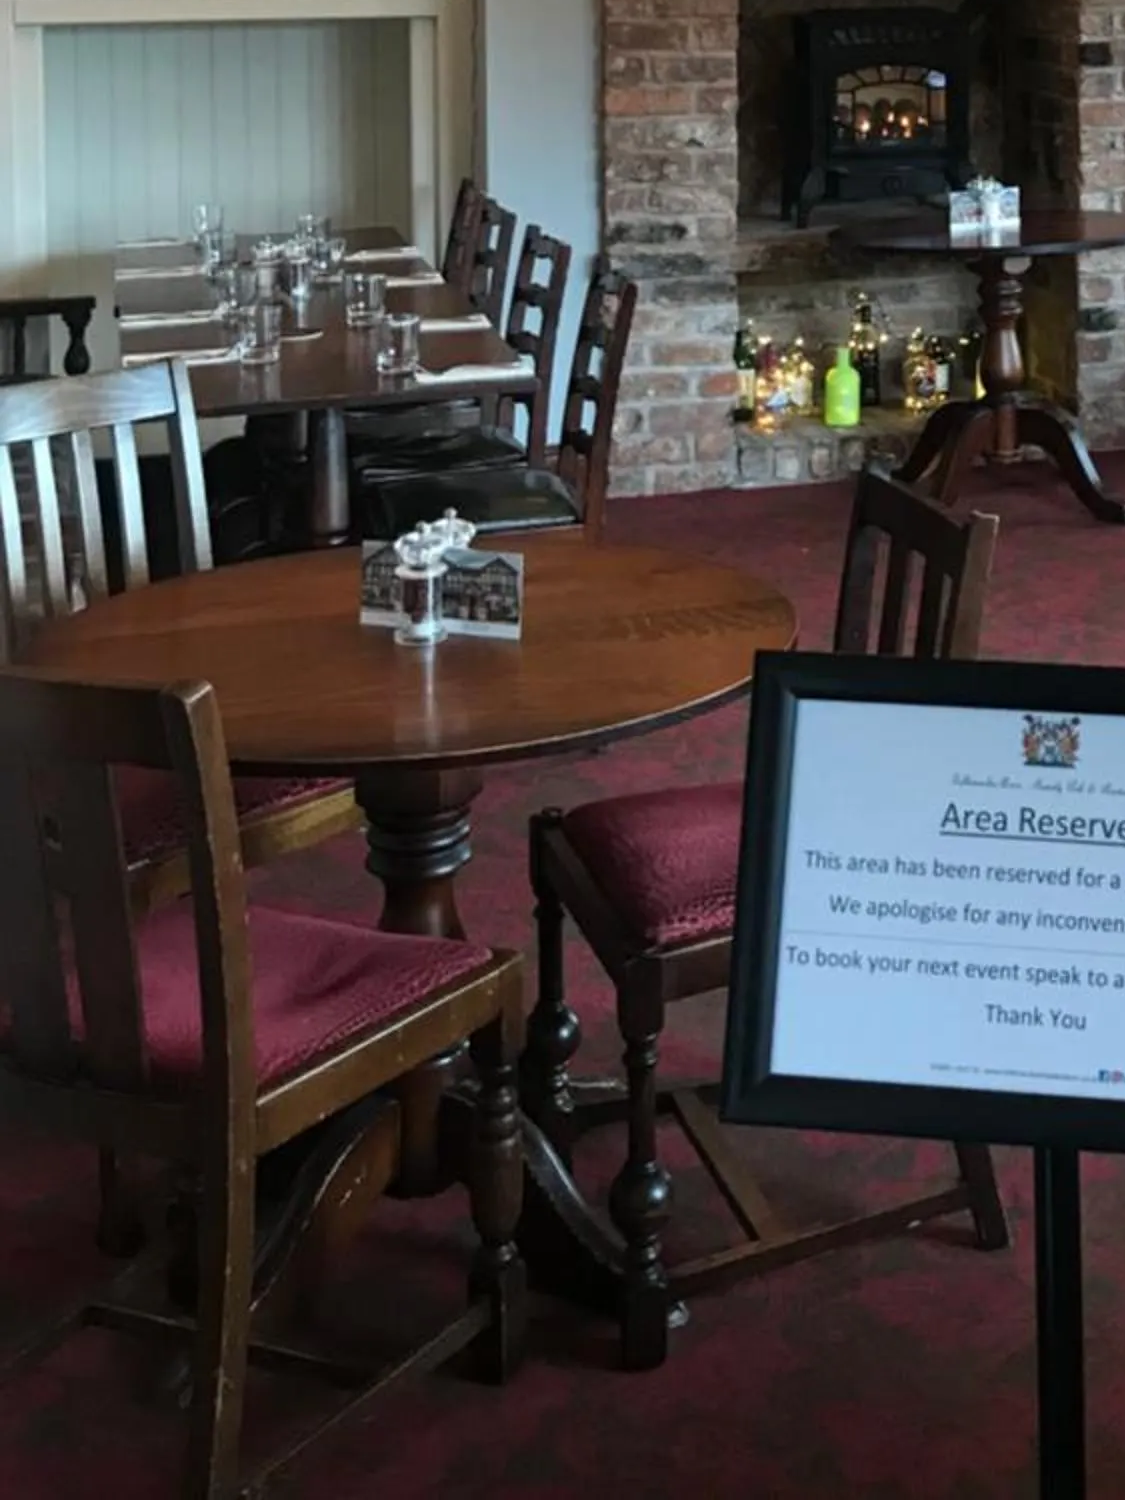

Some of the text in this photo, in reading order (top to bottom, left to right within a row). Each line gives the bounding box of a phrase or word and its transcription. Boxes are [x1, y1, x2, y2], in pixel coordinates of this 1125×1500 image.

[941, 802, 1008, 832] Area
[804, 850, 842, 870] This
[846, 857, 889, 873] area
[895, 857, 927, 876] has
[932, 859, 980, 879] been
[986, 867, 1070, 886] reserved
[1076, 868, 1106, 887] for
[1109, 875, 1121, 890] a
[829, 895, 862, 914] We
[866, 900, 957, 924] apologise
[963, 904, 991, 924] for
[996, 911, 1033, 931] any
[786, 946, 810, 965] To
[815, 948, 862, 968] book
[867, 956, 912, 976] your
[917, 960, 959, 976] next
[964, 964, 1020, 981] event
[1025, 965, 1081, 988] speak
[1088, 970, 1108, 988] to
[1113, 974, 1125, 989] a
[985, 1004, 1086, 1030] Thank You
